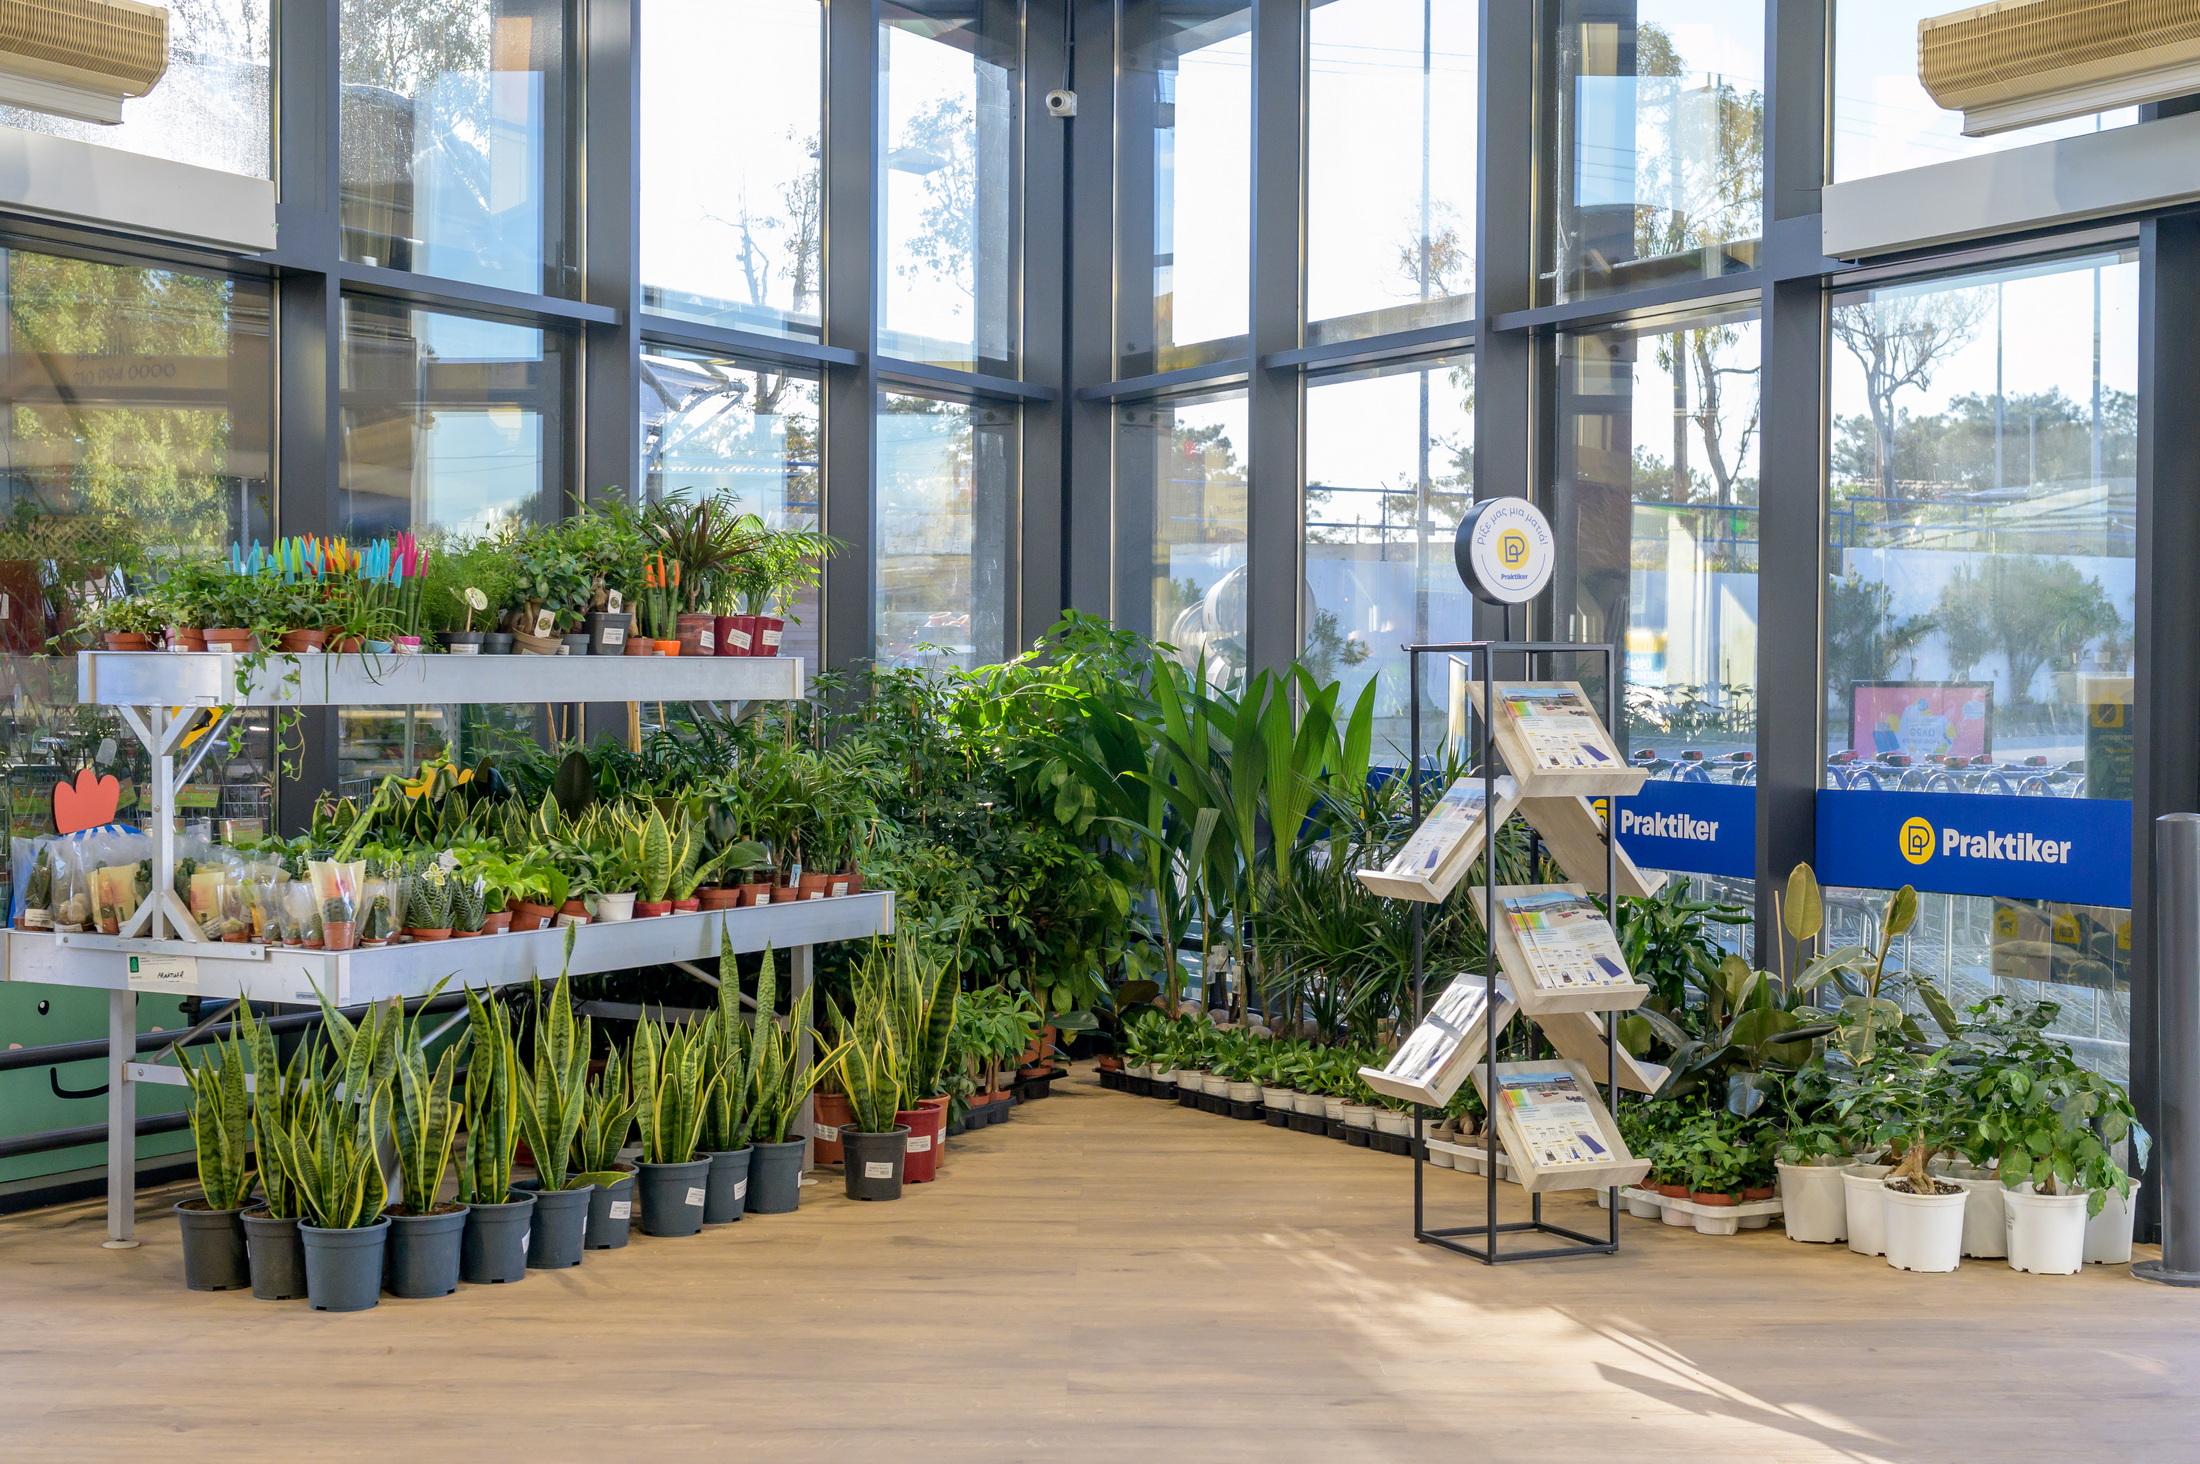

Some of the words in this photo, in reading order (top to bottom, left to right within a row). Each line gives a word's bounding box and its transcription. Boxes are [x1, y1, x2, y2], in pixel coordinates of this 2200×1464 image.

[128, 363, 176, 380] 0000
[1490, 508, 1508, 524] μας
[1509, 507, 1525, 517] μια
[1525, 513, 1549, 545] ματιά!
[1621, 809, 1719, 841] Praktiker
[1942, 828, 2072, 864] Praktiker
